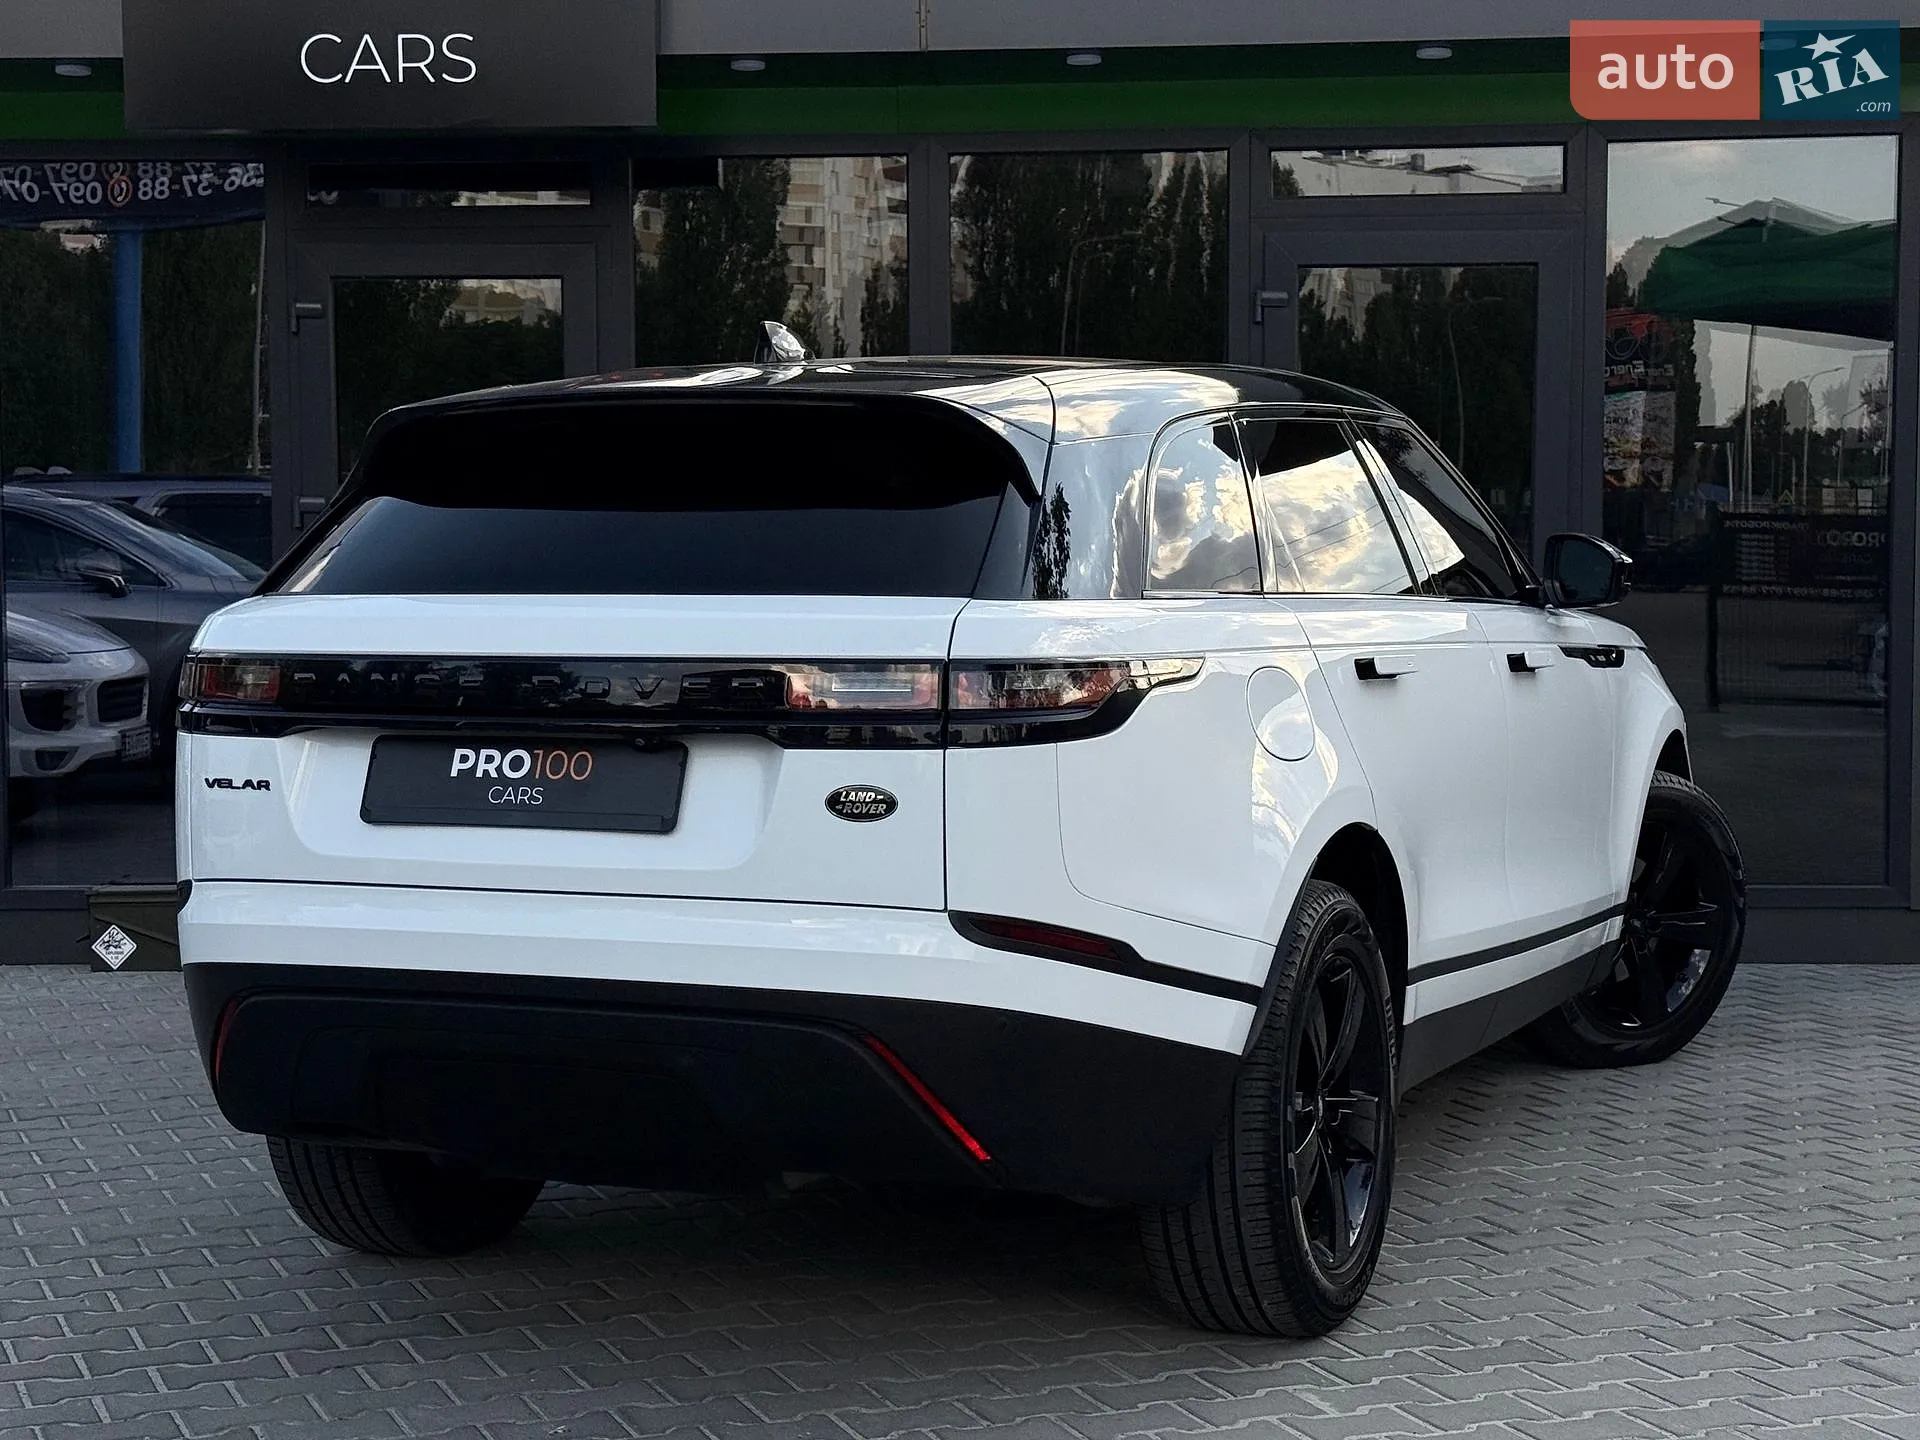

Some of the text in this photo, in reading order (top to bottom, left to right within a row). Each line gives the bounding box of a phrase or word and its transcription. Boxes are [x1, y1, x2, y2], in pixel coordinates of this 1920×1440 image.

[300, 33, 477, 84] CARS
[449, 748, 593, 781] PRO100
[204, 777, 271, 792] VELAR
[488, 785, 544, 805] CARS
